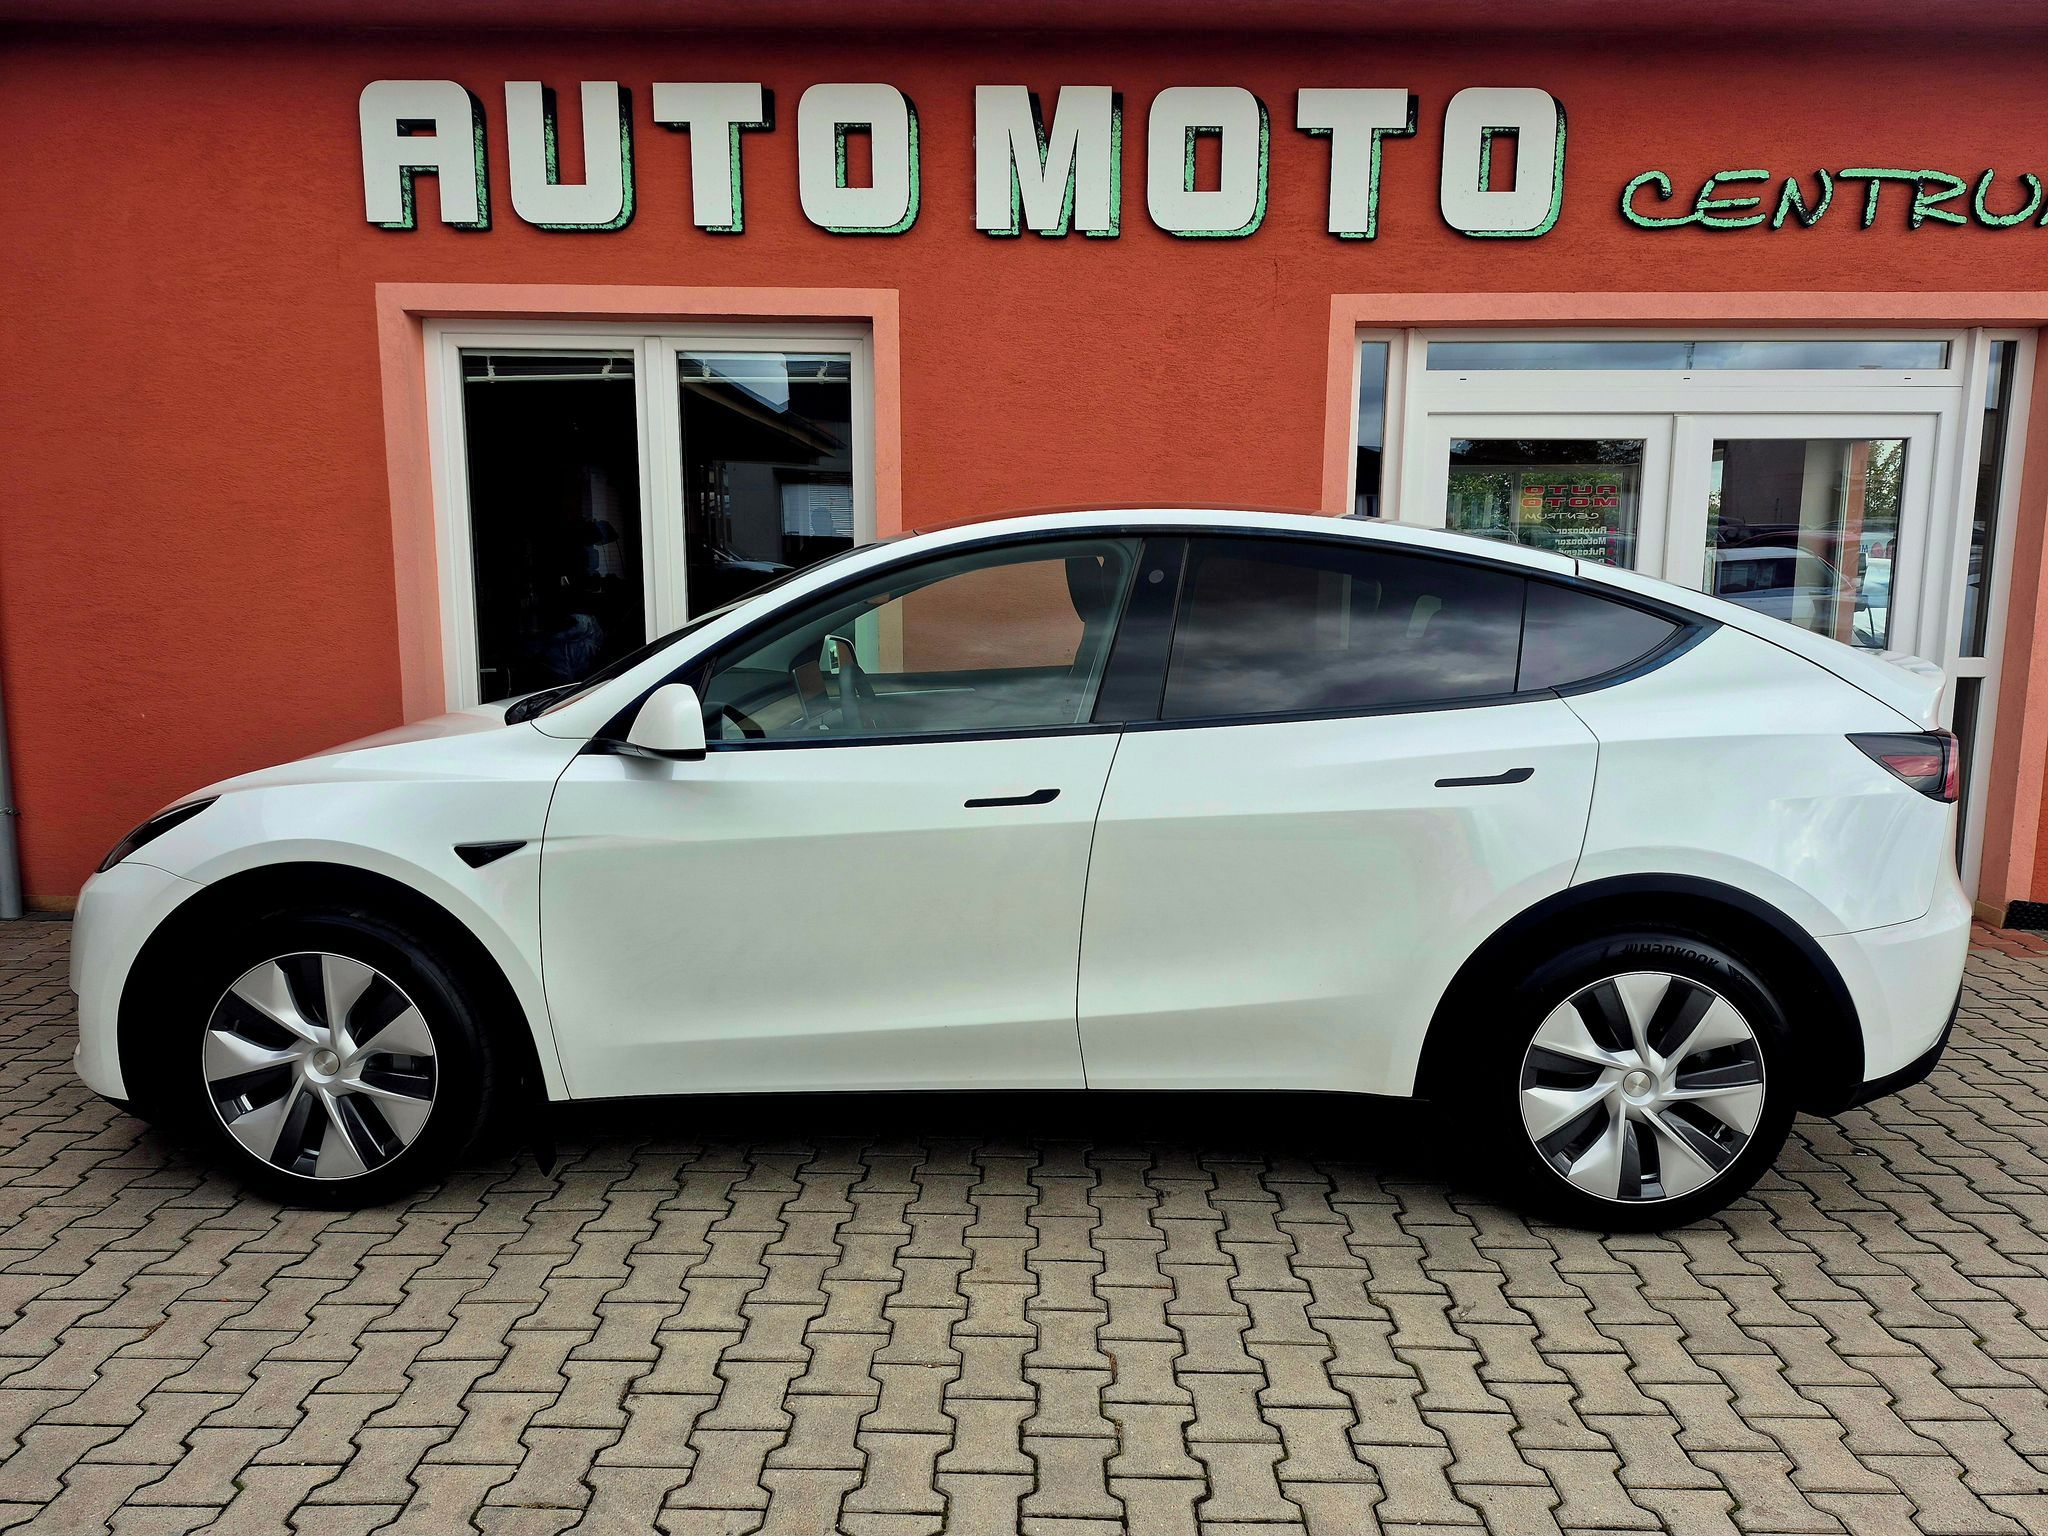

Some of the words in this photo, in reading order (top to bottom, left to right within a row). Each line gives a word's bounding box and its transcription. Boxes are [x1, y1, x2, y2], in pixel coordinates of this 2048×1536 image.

[359, 79, 920, 235] AUTO
[974, 85, 1567, 239] MOTO
[1620, 167, 2048, 231] CENTRU
[1637, 943, 1720, 968] Hankook
